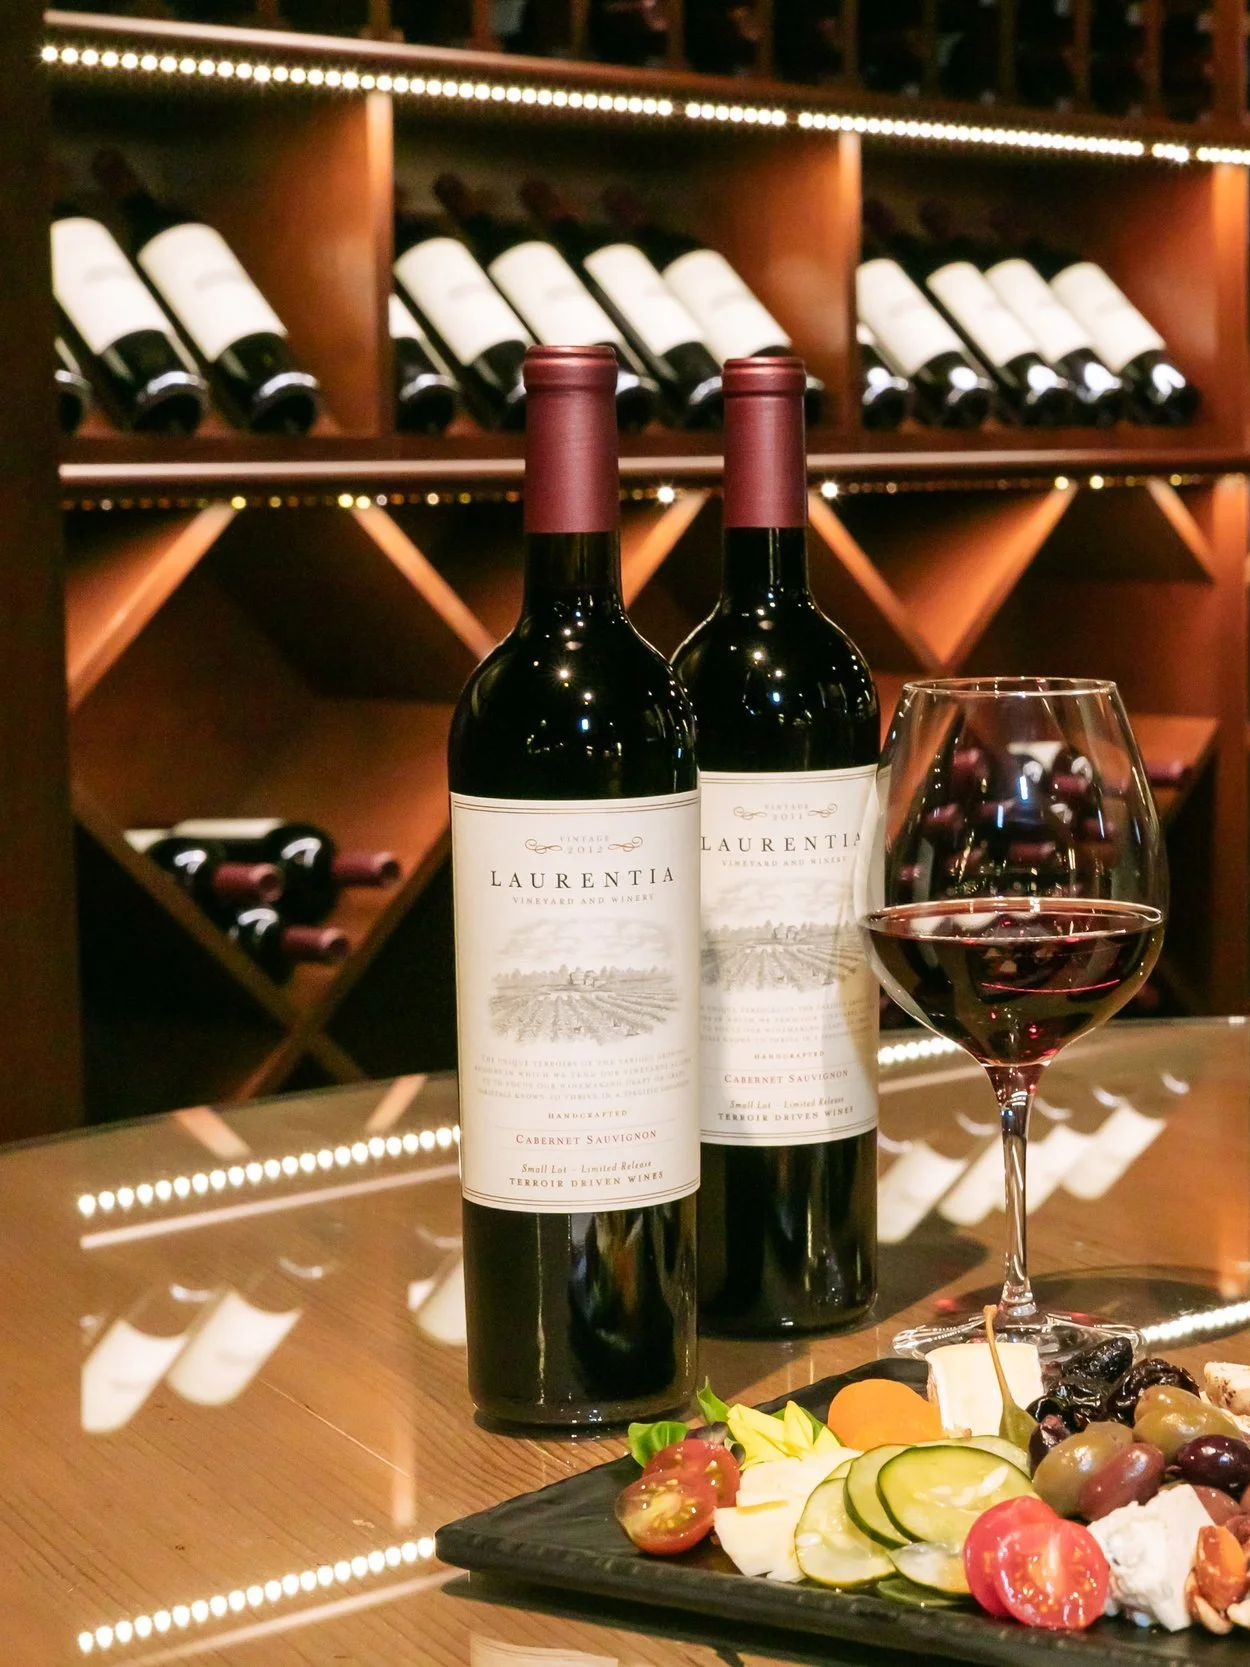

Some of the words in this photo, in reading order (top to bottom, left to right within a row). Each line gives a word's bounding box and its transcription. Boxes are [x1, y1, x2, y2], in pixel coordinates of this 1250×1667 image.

[559, 835, 610, 843] VINTAGE
[701, 832, 860, 852] LAURENTIA
[567, 846, 604, 854] 2012
[722, 859, 778, 867] VINEYARD
[783, 859, 804, 867] AND
[490, 867, 675, 889] LAURENTIA
[512, 896, 574, 905] VINEYARD
[581, 897, 605, 905] AND
[611, 893, 654, 903] WINERY
[548, 1109, 628, 1120] HANDCRAFTED
[775, 1112, 819, 1122] DRIVEN
[521, 1163, 548, 1174] Small
[551, 1164, 567, 1174] Lot
[581, 1163, 617, 1173] Limited
[621, 1160, 652, 1171] Release
[509, 1177, 564, 1188] TERROIR
[571, 1177, 621, 1188] DRIVEN
[628, 1171, 664, 1183] WINES
